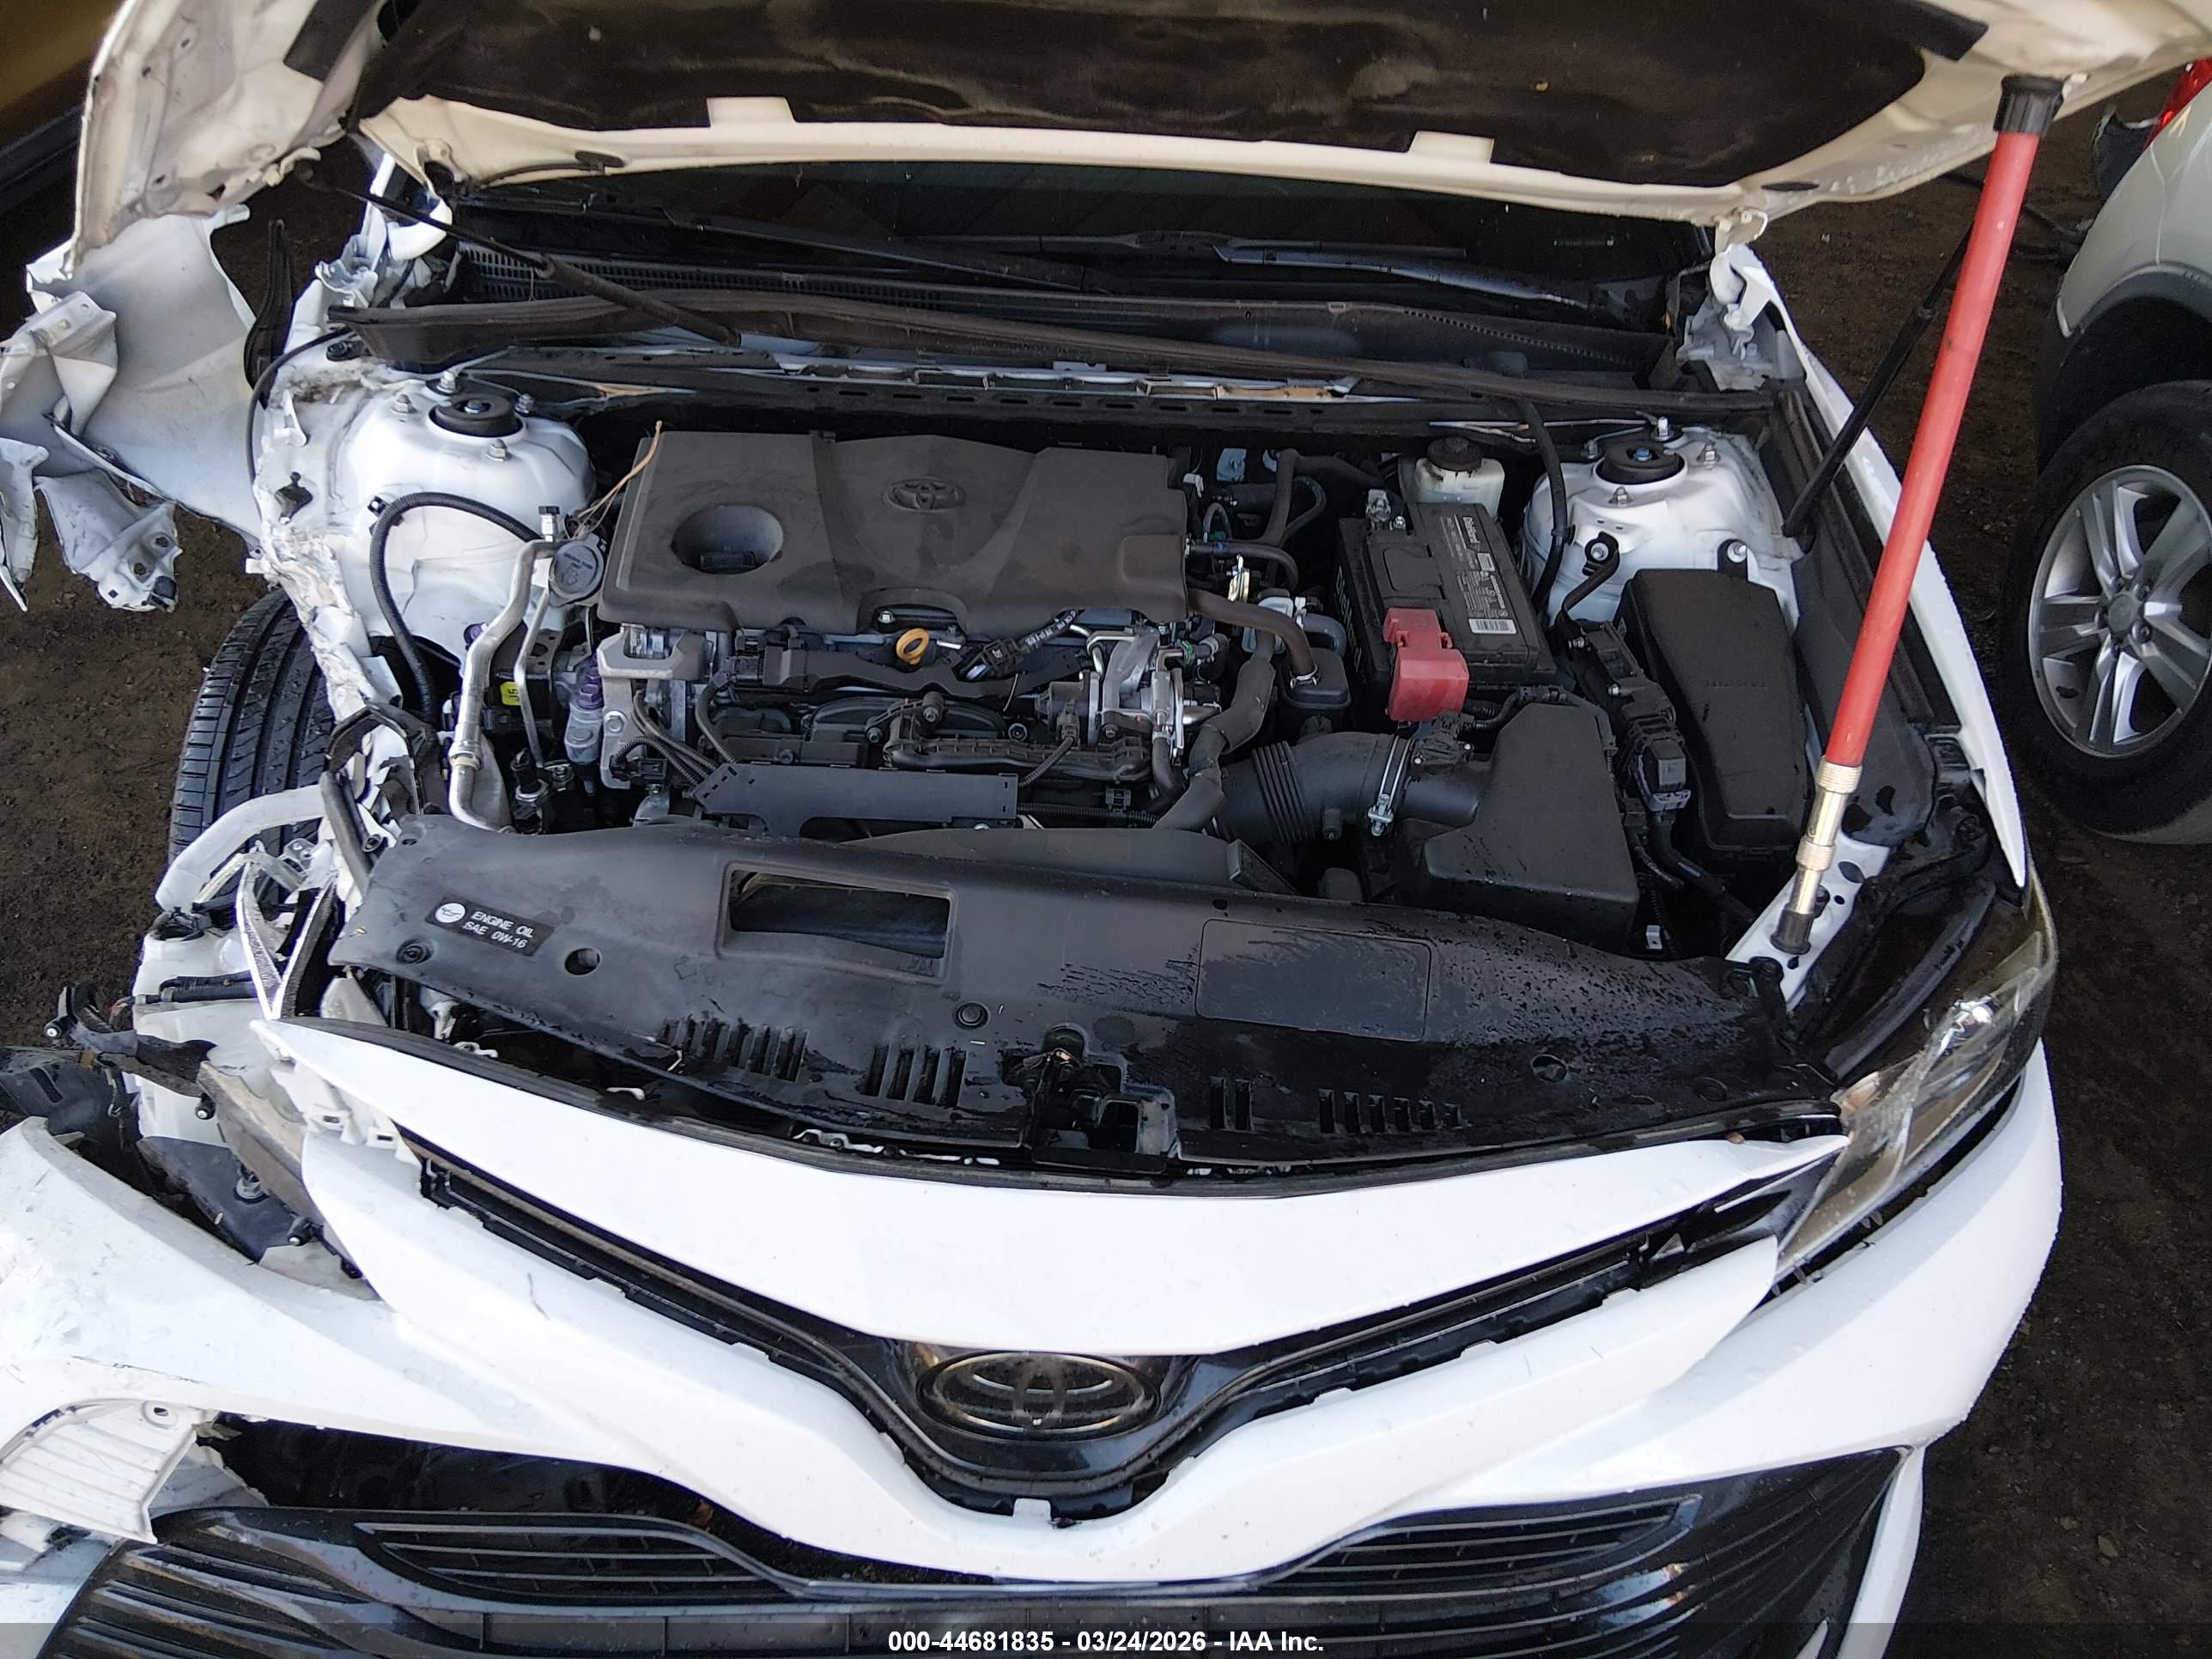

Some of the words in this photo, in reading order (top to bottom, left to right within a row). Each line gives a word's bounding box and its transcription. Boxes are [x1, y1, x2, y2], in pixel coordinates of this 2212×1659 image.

[463, 921, 489, 935] SAE
[491, 931, 528, 949] 0W-16
[471, 911, 514, 930] ENGINE
[516, 926, 535, 939] OIL
